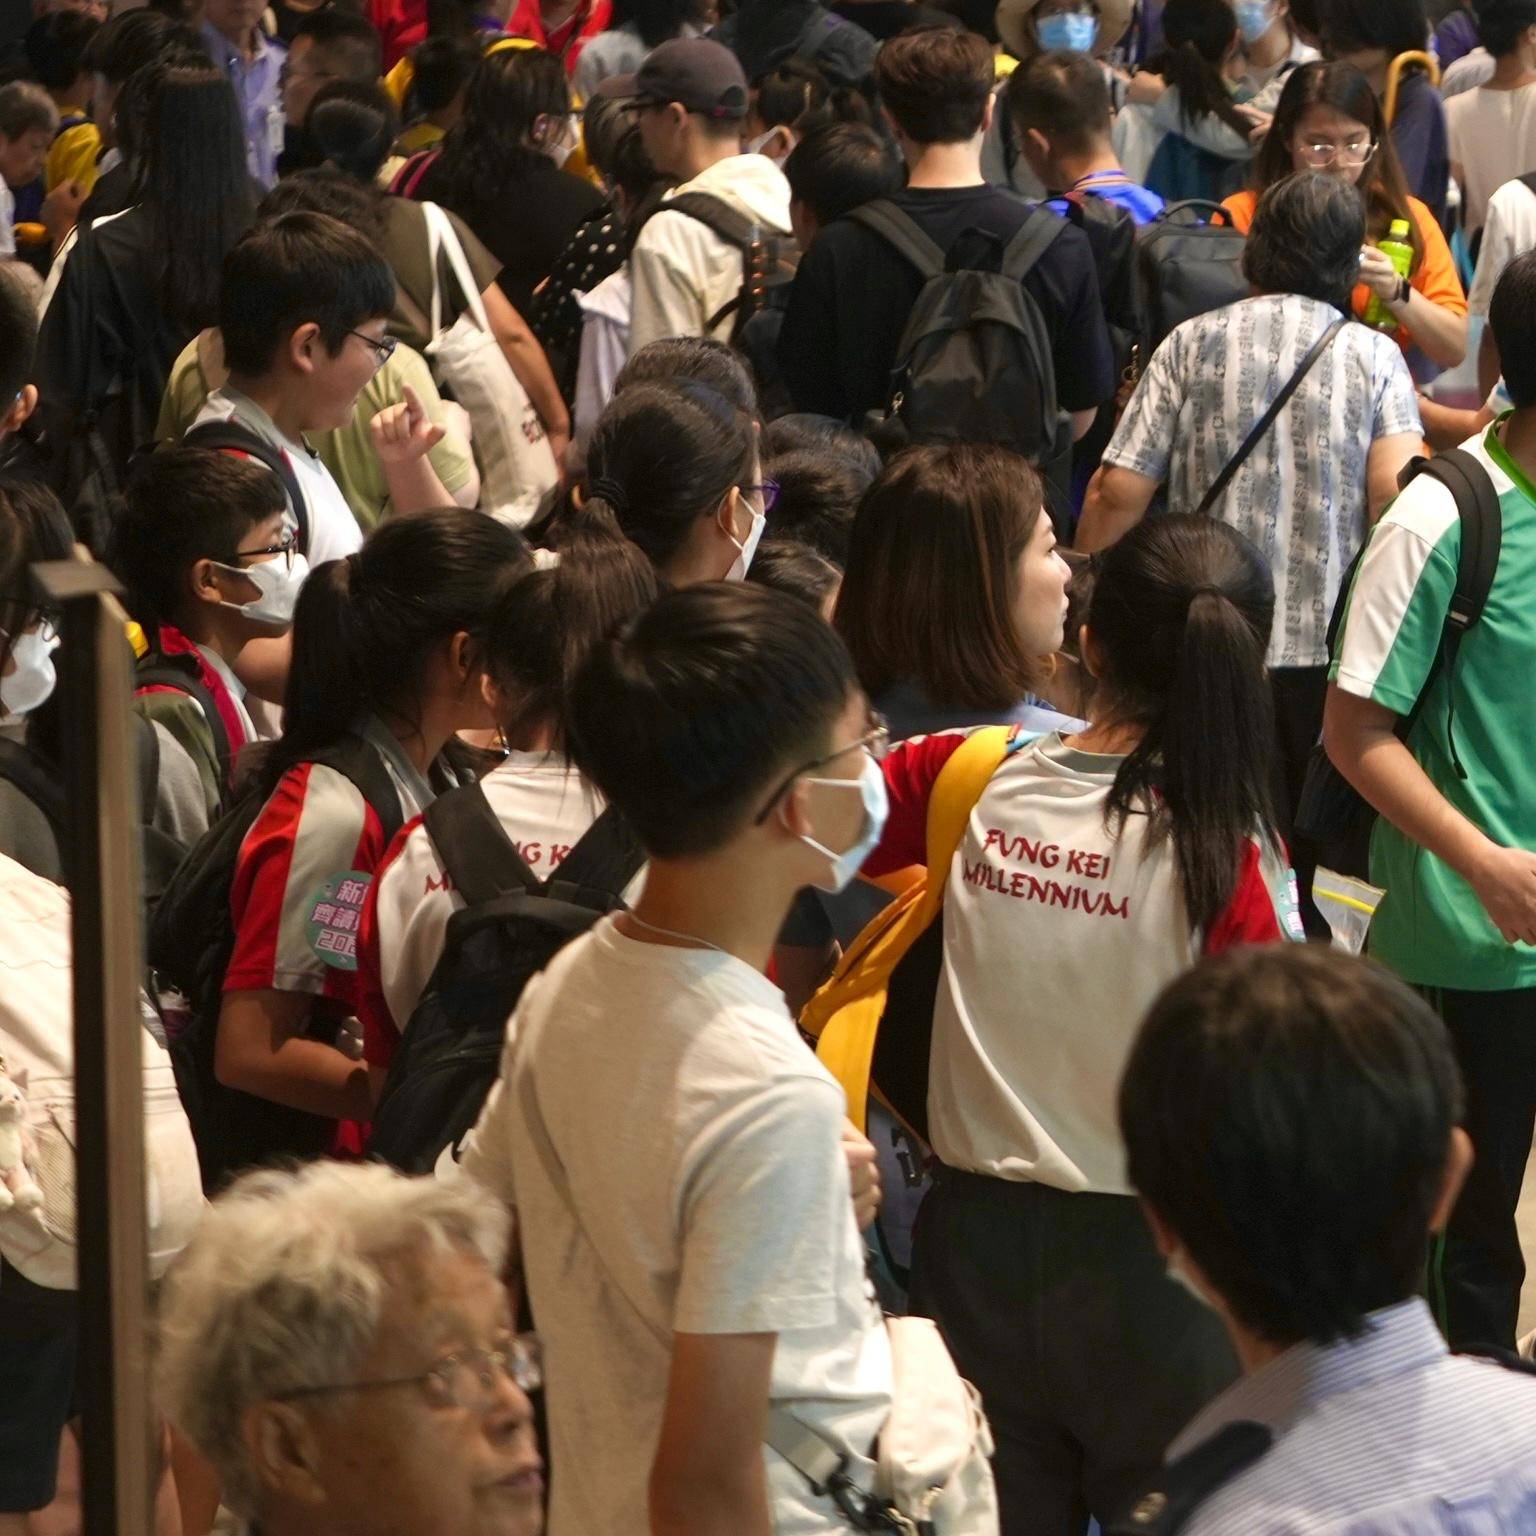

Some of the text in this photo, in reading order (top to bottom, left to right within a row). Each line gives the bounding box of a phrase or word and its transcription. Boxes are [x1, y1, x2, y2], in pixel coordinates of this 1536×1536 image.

[984, 828, 1111, 881] FUNG KEI
[962, 858, 1131, 920] MILLENNIUM
